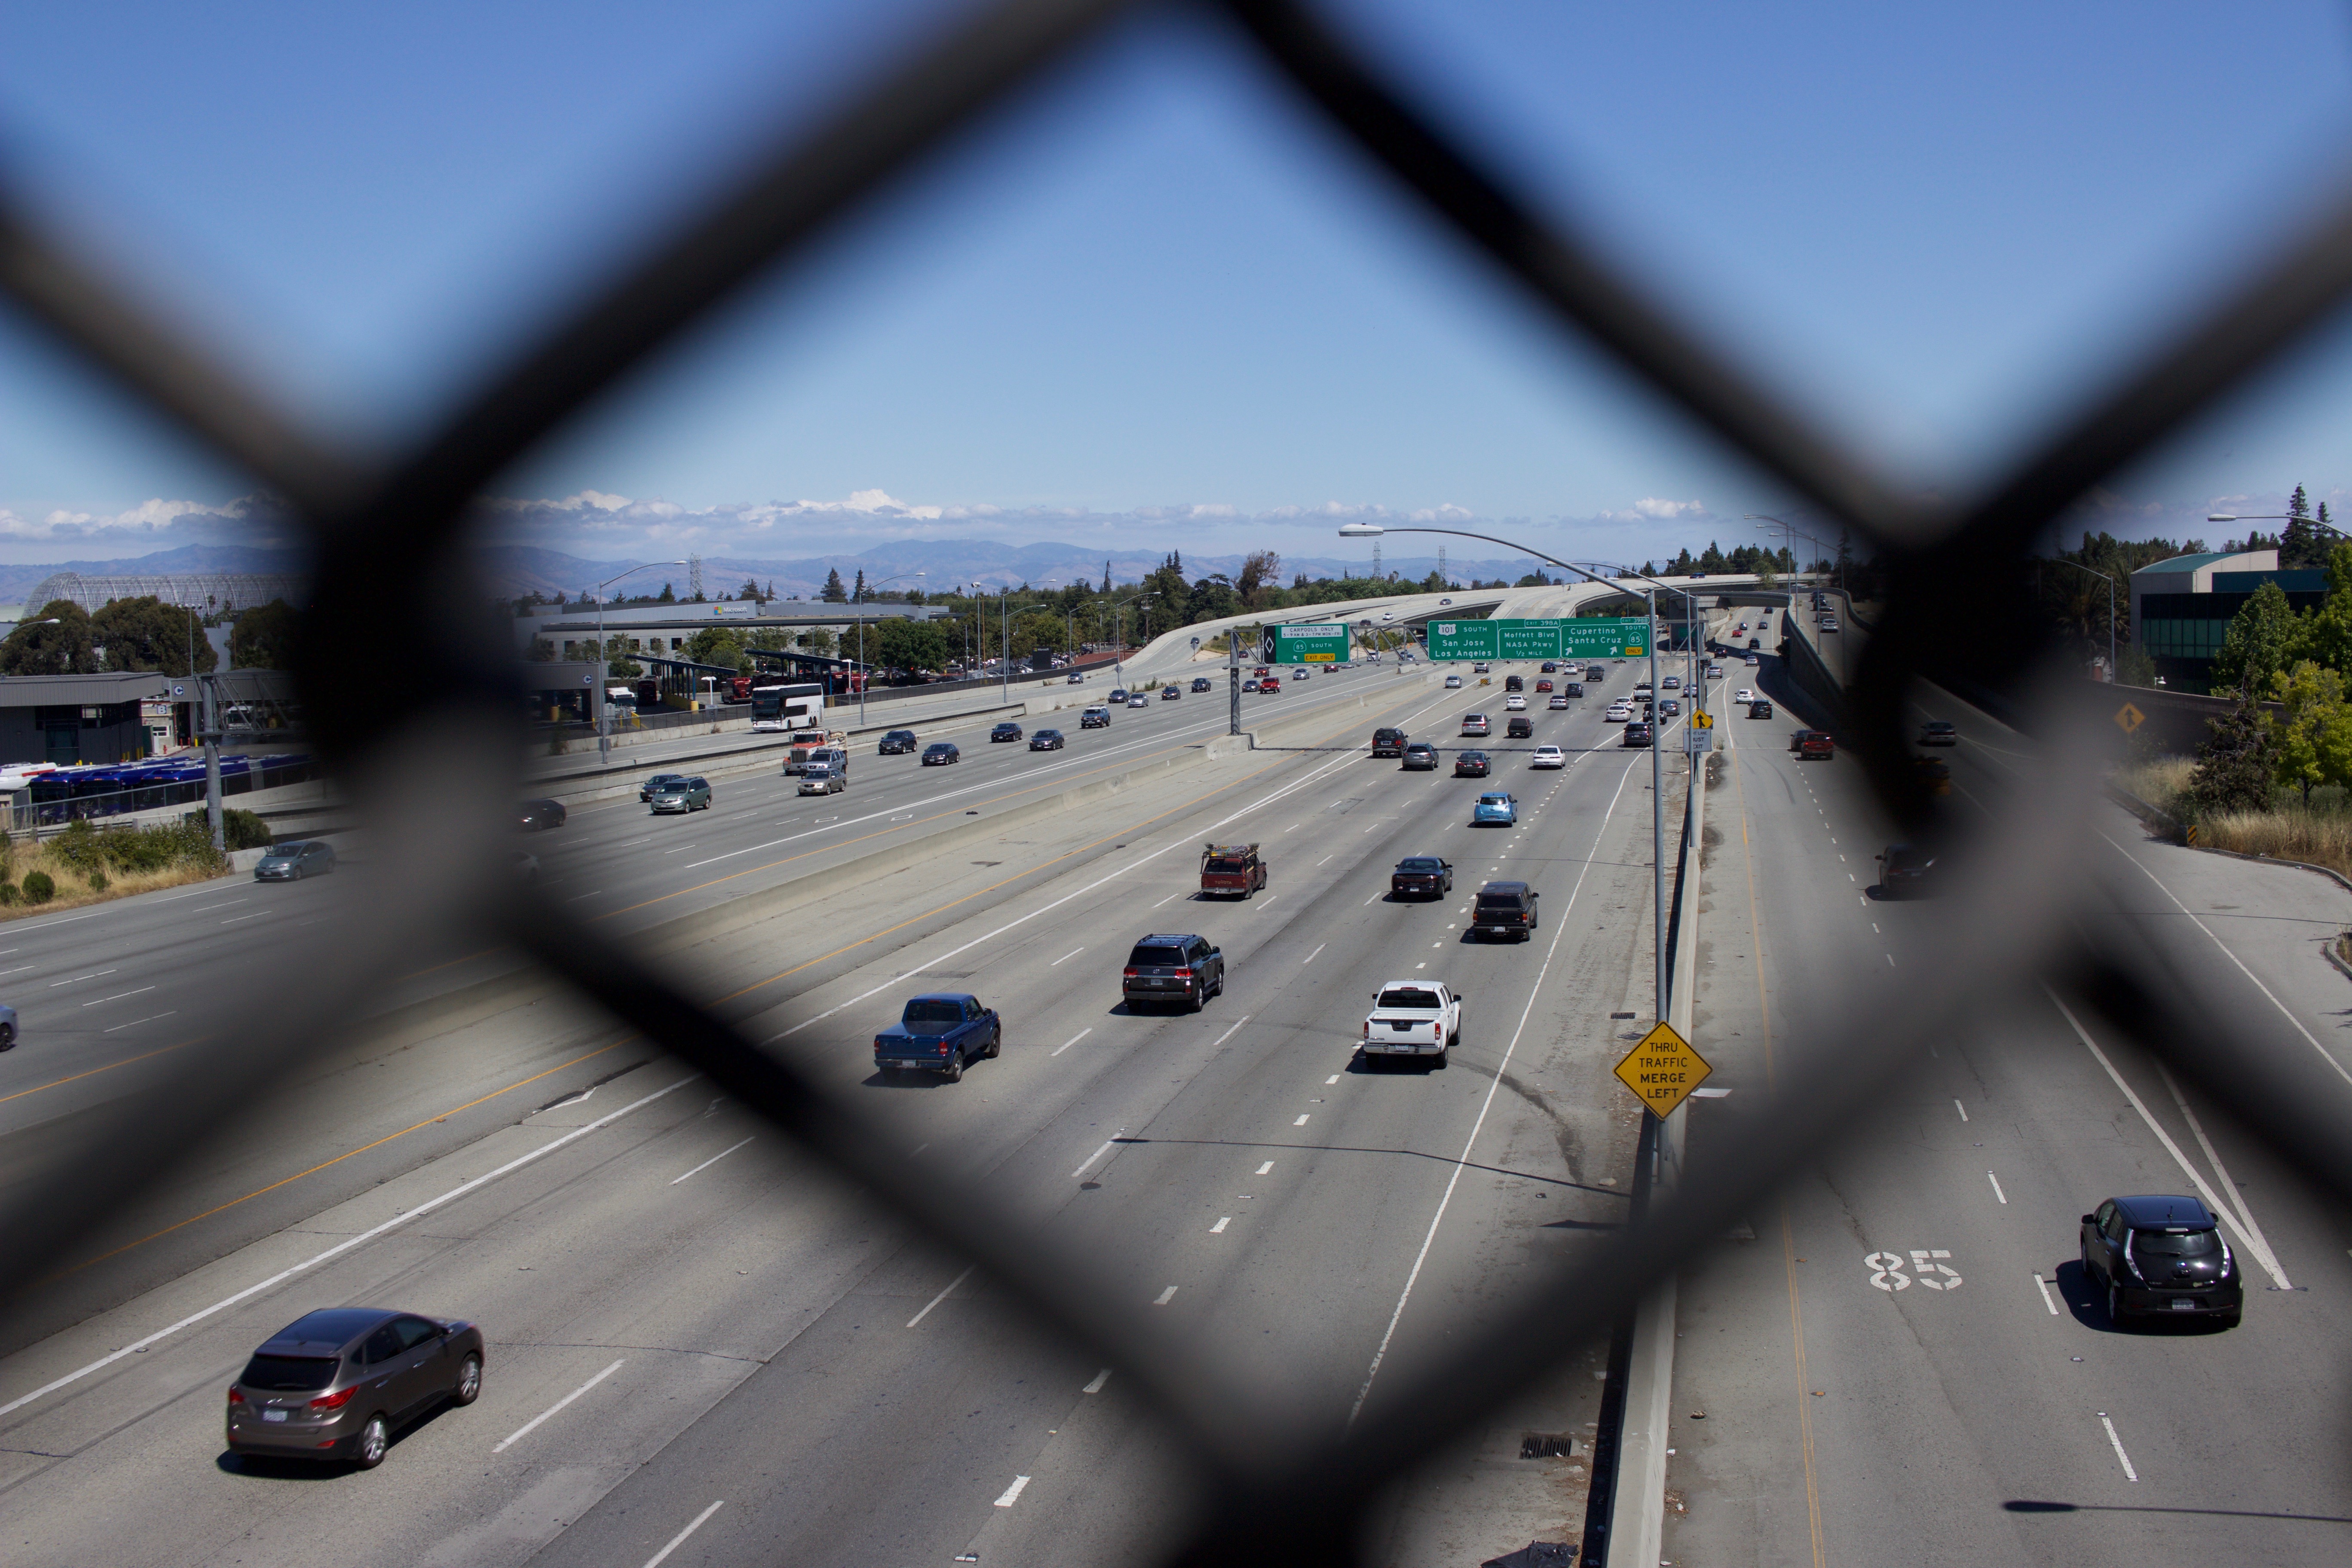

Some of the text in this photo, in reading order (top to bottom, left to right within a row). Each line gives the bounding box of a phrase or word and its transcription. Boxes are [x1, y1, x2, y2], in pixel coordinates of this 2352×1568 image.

[1456, 650, 1491, 658] Angeles
[584, 675, 591, 683] C
[175, 686, 183, 695] C
[158, 705, 166, 714] B
[1649, 1042, 1678, 1052] THRU
[1639, 1057, 1688, 1068] TRAFFIC
[1640, 1073, 1686, 1083] MERGE
[1647, 1088, 1679, 1098] LEFT
[1864, 1250, 1962, 1292] 85
